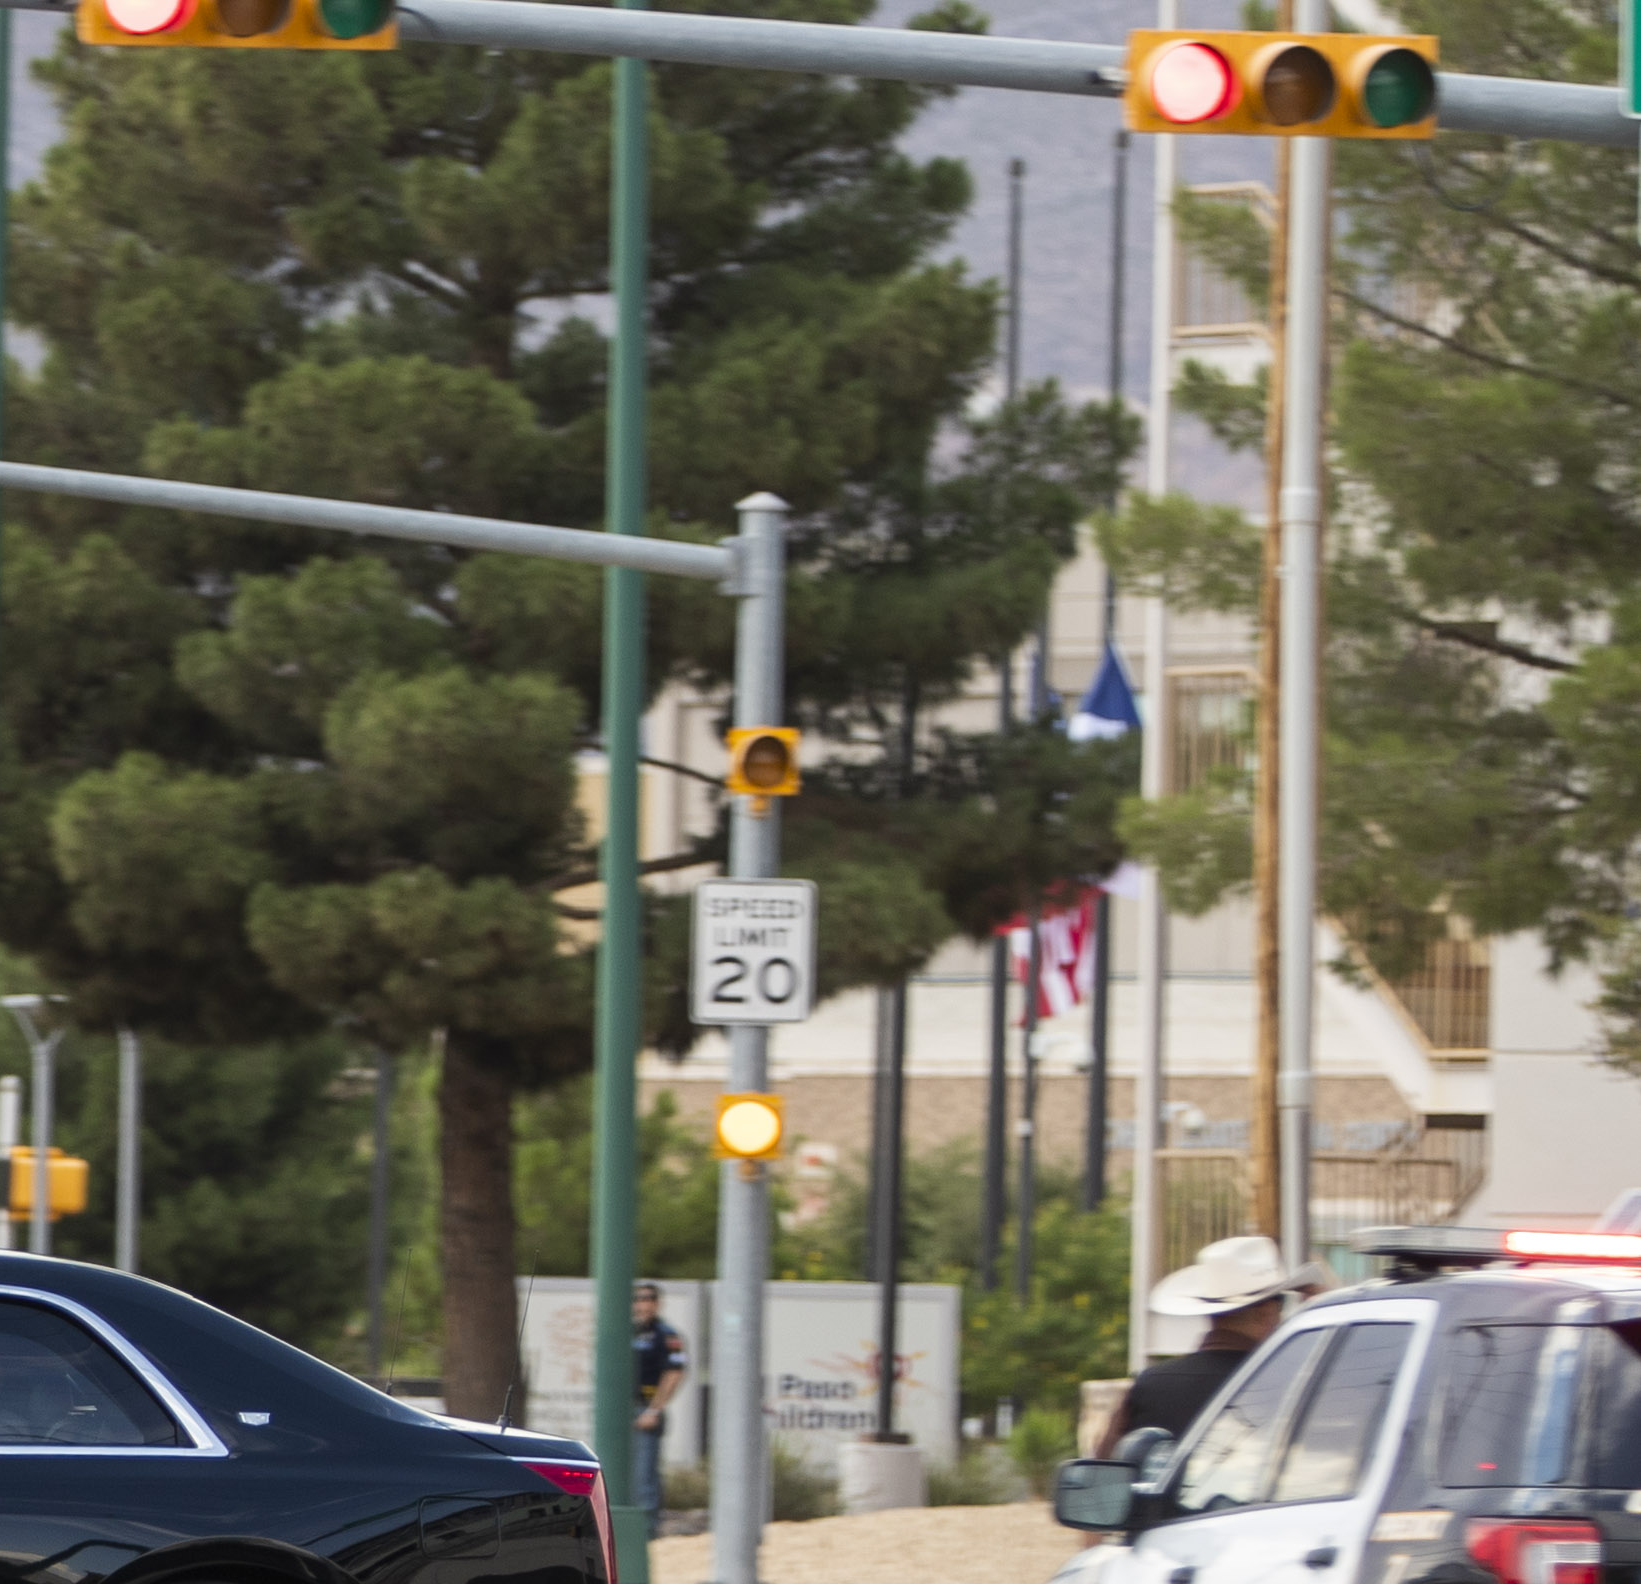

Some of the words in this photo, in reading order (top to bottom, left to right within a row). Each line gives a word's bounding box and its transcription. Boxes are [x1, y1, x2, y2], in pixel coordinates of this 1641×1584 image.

[706, 899, 804, 919] SPEED
[712, 927, 792, 947] LIMIT
[711, 956, 798, 1004] 20
